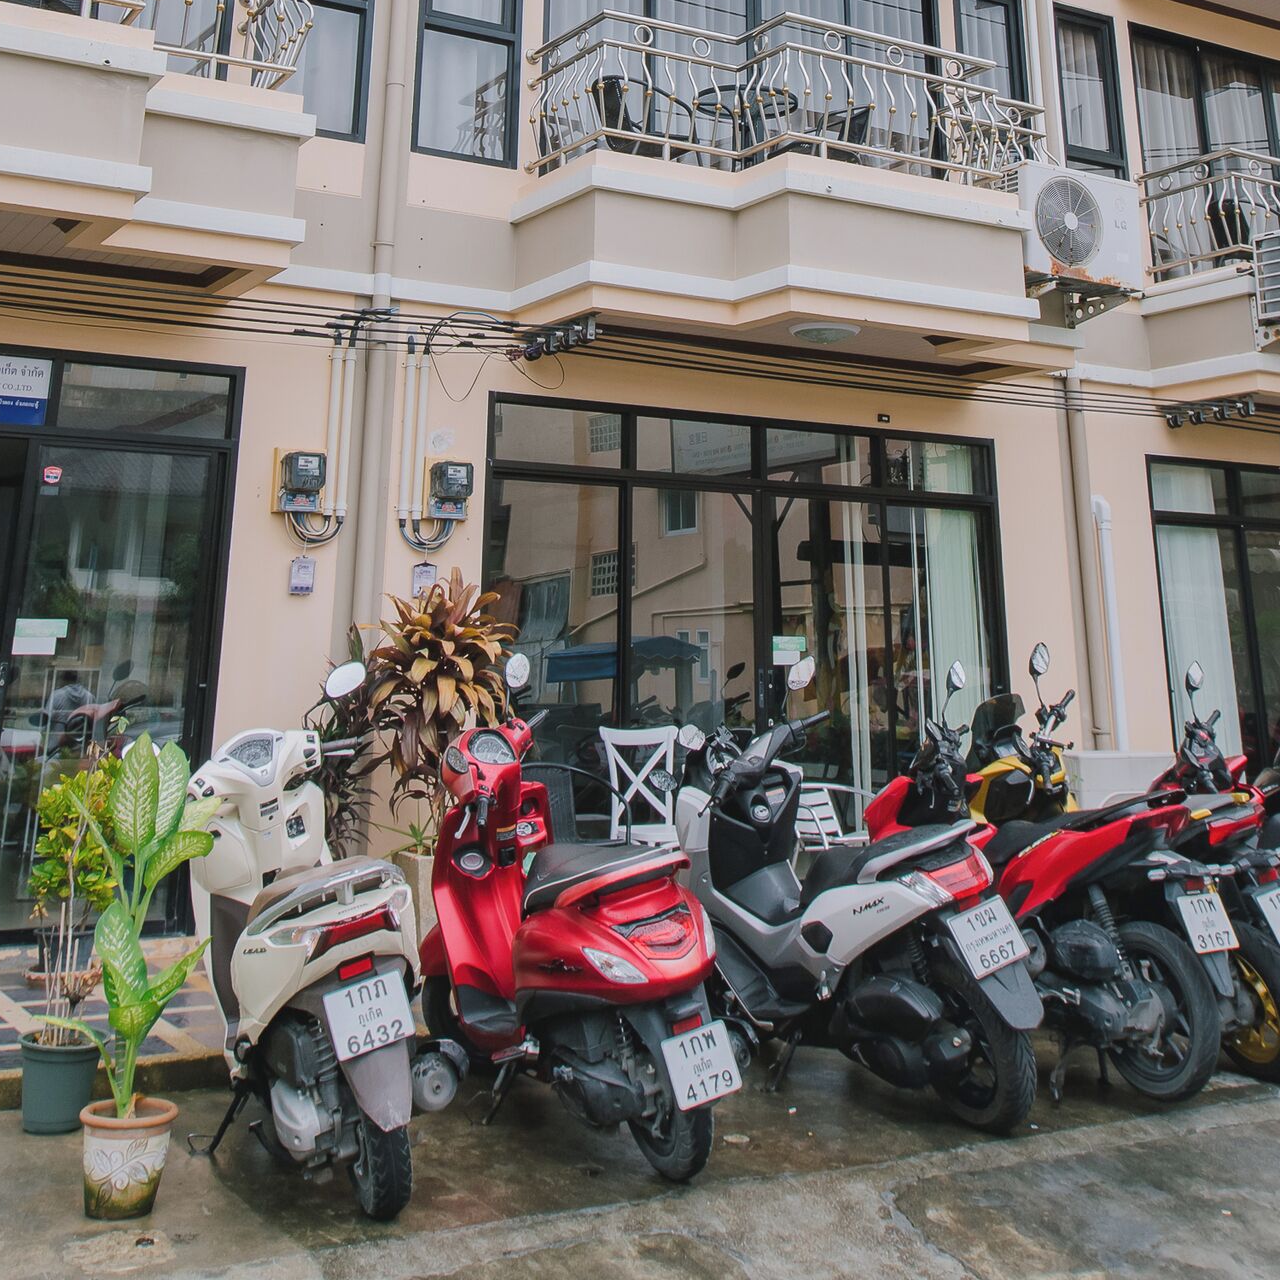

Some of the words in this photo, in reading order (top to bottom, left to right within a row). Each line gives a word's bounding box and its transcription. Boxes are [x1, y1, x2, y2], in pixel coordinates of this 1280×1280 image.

[21, 365, 44, 378] จำกัด
[979, 939, 1016, 969] 6667
[1197, 930, 1232, 949] 3167
[347, 1019, 406, 1054] 6432
[687, 1069, 733, 1101] 4179
